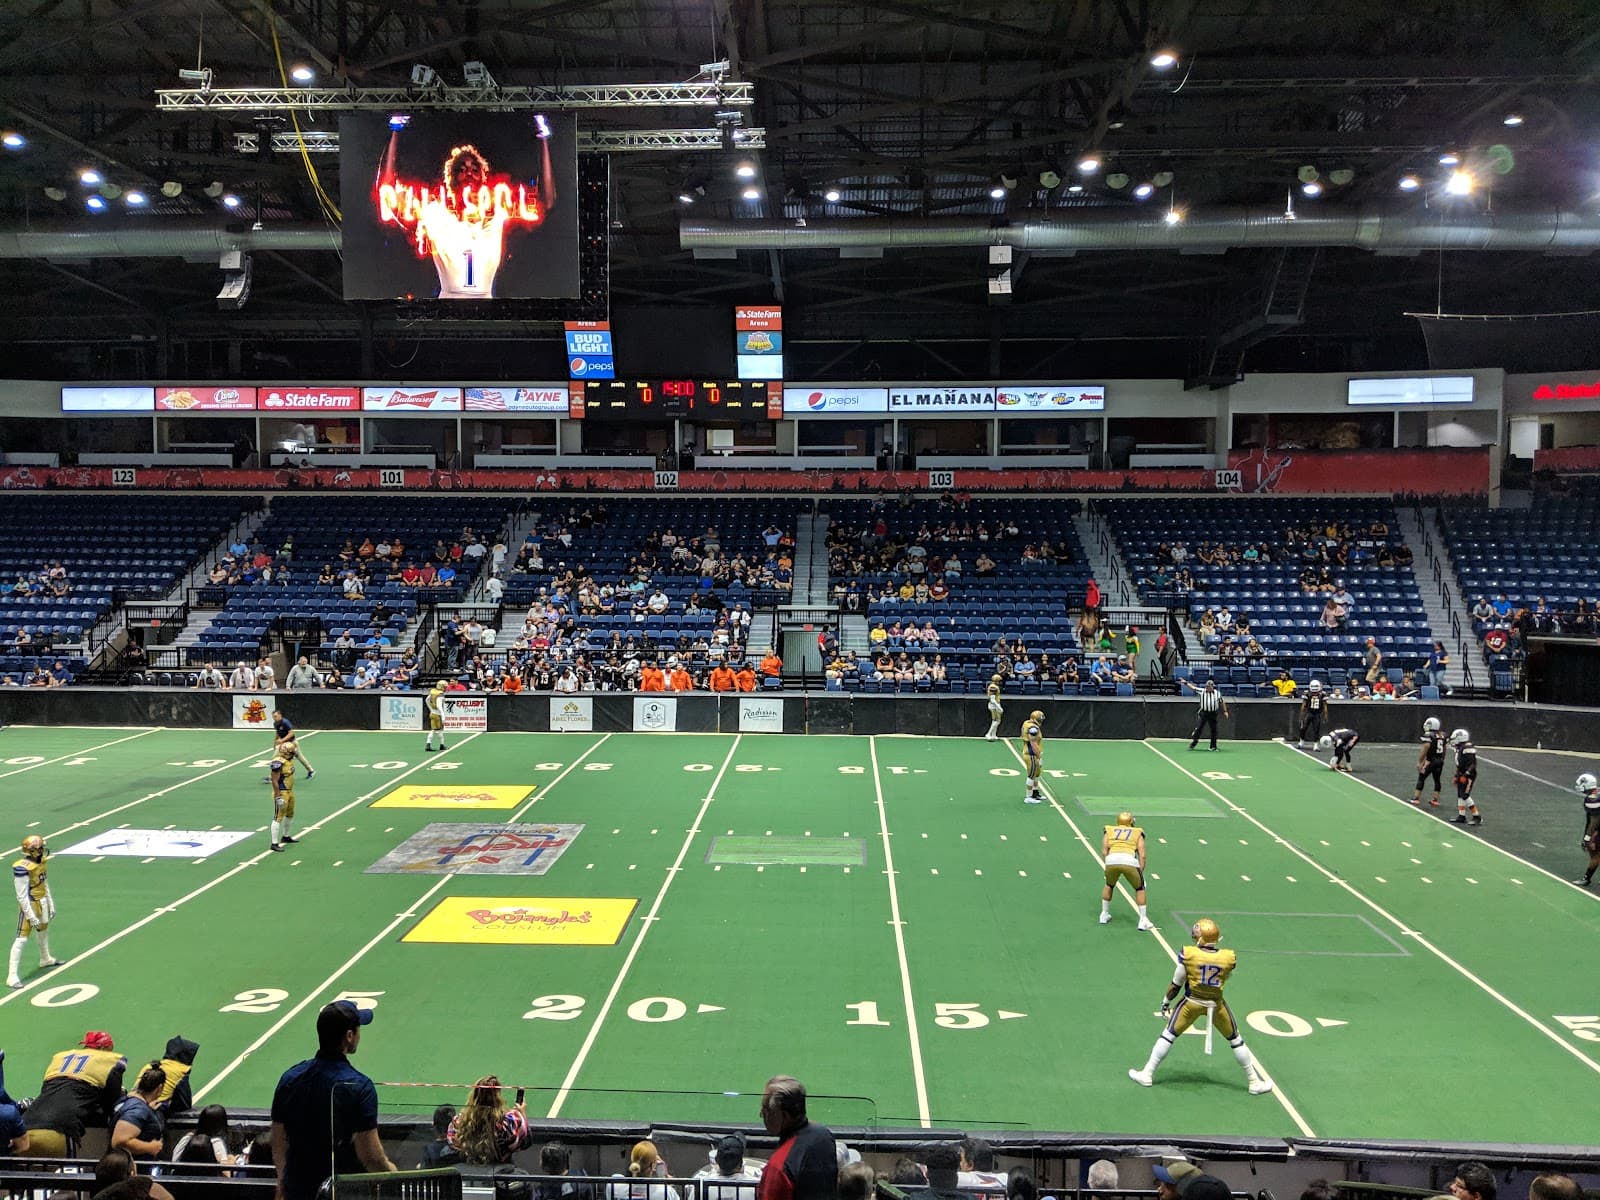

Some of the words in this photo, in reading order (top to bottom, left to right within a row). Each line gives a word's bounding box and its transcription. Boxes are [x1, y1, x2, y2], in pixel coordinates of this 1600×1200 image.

[463, 249, 476, 288] 1
[574, 334, 603, 343] BUD
[570, 343, 608, 352] LIGHT
[588, 361, 614, 371] pepsi
[391, 394, 435, 404] Budweiser
[514, 388, 561, 401] PAYNE
[643, 388, 652, 402] 0
[711, 388, 720, 402] 0
[828, 395, 859, 405] pepsi
[892, 395, 912, 405] EL
[916, 390, 993, 405] MAÑANA
[114, 471, 134, 483] 123
[382, 471, 403, 484] 101
[656, 472, 677, 485] 102
[931, 473, 951, 486] 103
[1217, 472, 1239, 485] 104
[388, 698, 416, 716] Rio
[1310, 697, 1320, 709] 12
[744, 707, 777, 720] Radisson
[1114, 829, 1133, 841] 77
[466, 908, 592, 925] Bojangles'
[1199, 965, 1222, 987] 12
[61, 1053, 89, 1074] 11
